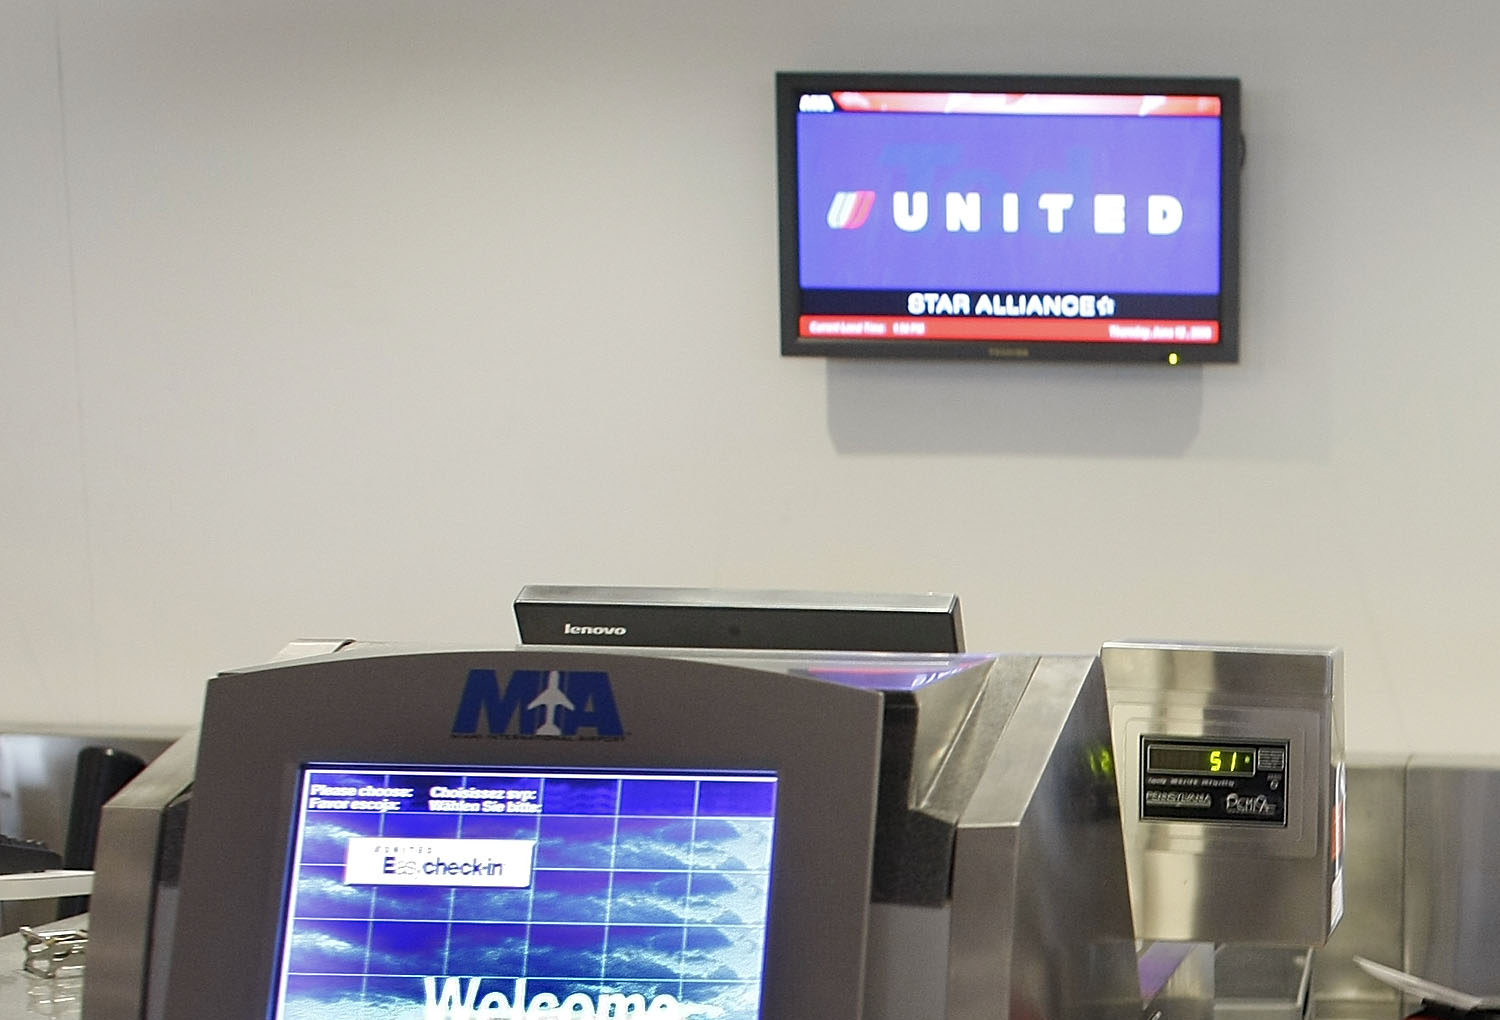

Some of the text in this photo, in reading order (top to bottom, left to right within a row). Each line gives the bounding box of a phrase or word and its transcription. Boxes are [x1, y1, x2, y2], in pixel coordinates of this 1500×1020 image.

[893, 191, 1184, 235] UNITED
[907, 292, 1096, 317] STAR ALLIANCE
[564, 623, 627, 636] lenovo
[451, 669, 625, 736] MIA
[1209, 750, 1238, 772] 51
[310, 784, 415, 798] Please choose:
[429, 786, 537, 803] Choisissez svp:
[308, 797, 401, 813] Favor escoja:
[428, 799, 543, 813] Wählen Sie bitte:
[422, 857, 503, 876] check-in
